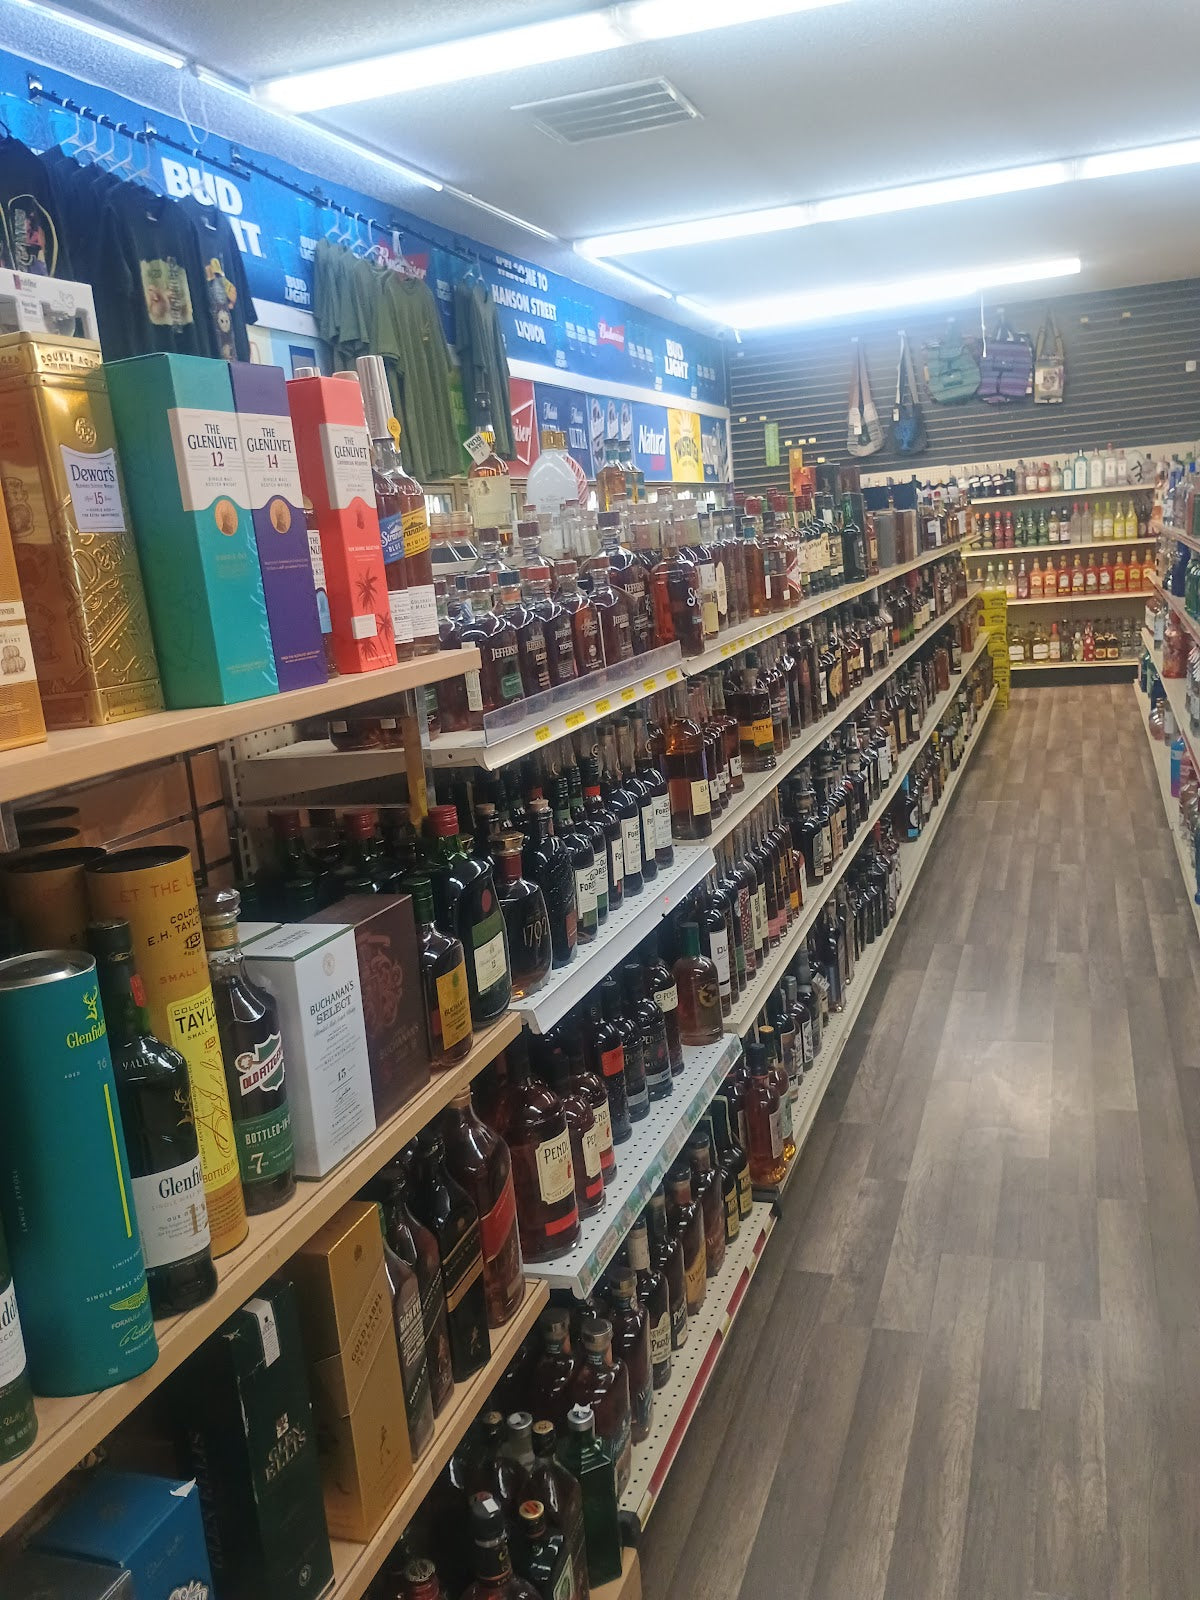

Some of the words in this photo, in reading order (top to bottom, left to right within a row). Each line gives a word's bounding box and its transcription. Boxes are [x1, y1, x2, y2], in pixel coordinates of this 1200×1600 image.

[161, 157, 243, 216] BUD
[284, 274, 308, 292] BUD
[537, 272, 548, 292] TO
[284, 286, 311, 305] LIGHT
[491, 284, 530, 313] HANSON
[530, 297, 557, 321] STREET
[514, 319, 546, 345] LIQUOR
[665, 338, 684, 361] BUD
[664, 355, 689, 380] LIGHT
[204, 423, 221, 435] THE
[261, 427, 276, 438] THE
[187, 434, 237, 453] GLENLIVET
[246, 437, 292, 453] GLENLIVET
[344, 436, 355, 446] THE
[638, 424, 666, 455] Natural
[210, 451, 225, 467] 12
[267, 454, 279, 468] 14
[334, 445, 367, 460] GLENLIVET
[70, 464, 115, 482] Dewar's
[94, 491, 104, 505] 15
[150, 879, 182, 898] THE
[148, 931, 173, 946] E.H.
[523, 916, 549, 947] 1792
[159, 967, 198, 985] SMALL
[316, 994, 352, 1025] SELECT
[187, 1027, 209, 1041] SMALL
[242, 1071, 260, 1090] OLD
[337, 1067, 347, 1082] 15
[250, 1152, 264, 1174] 7
[86, 1289, 112, 1303] SINGLE
[115, 1279, 132, 1294] MALT
